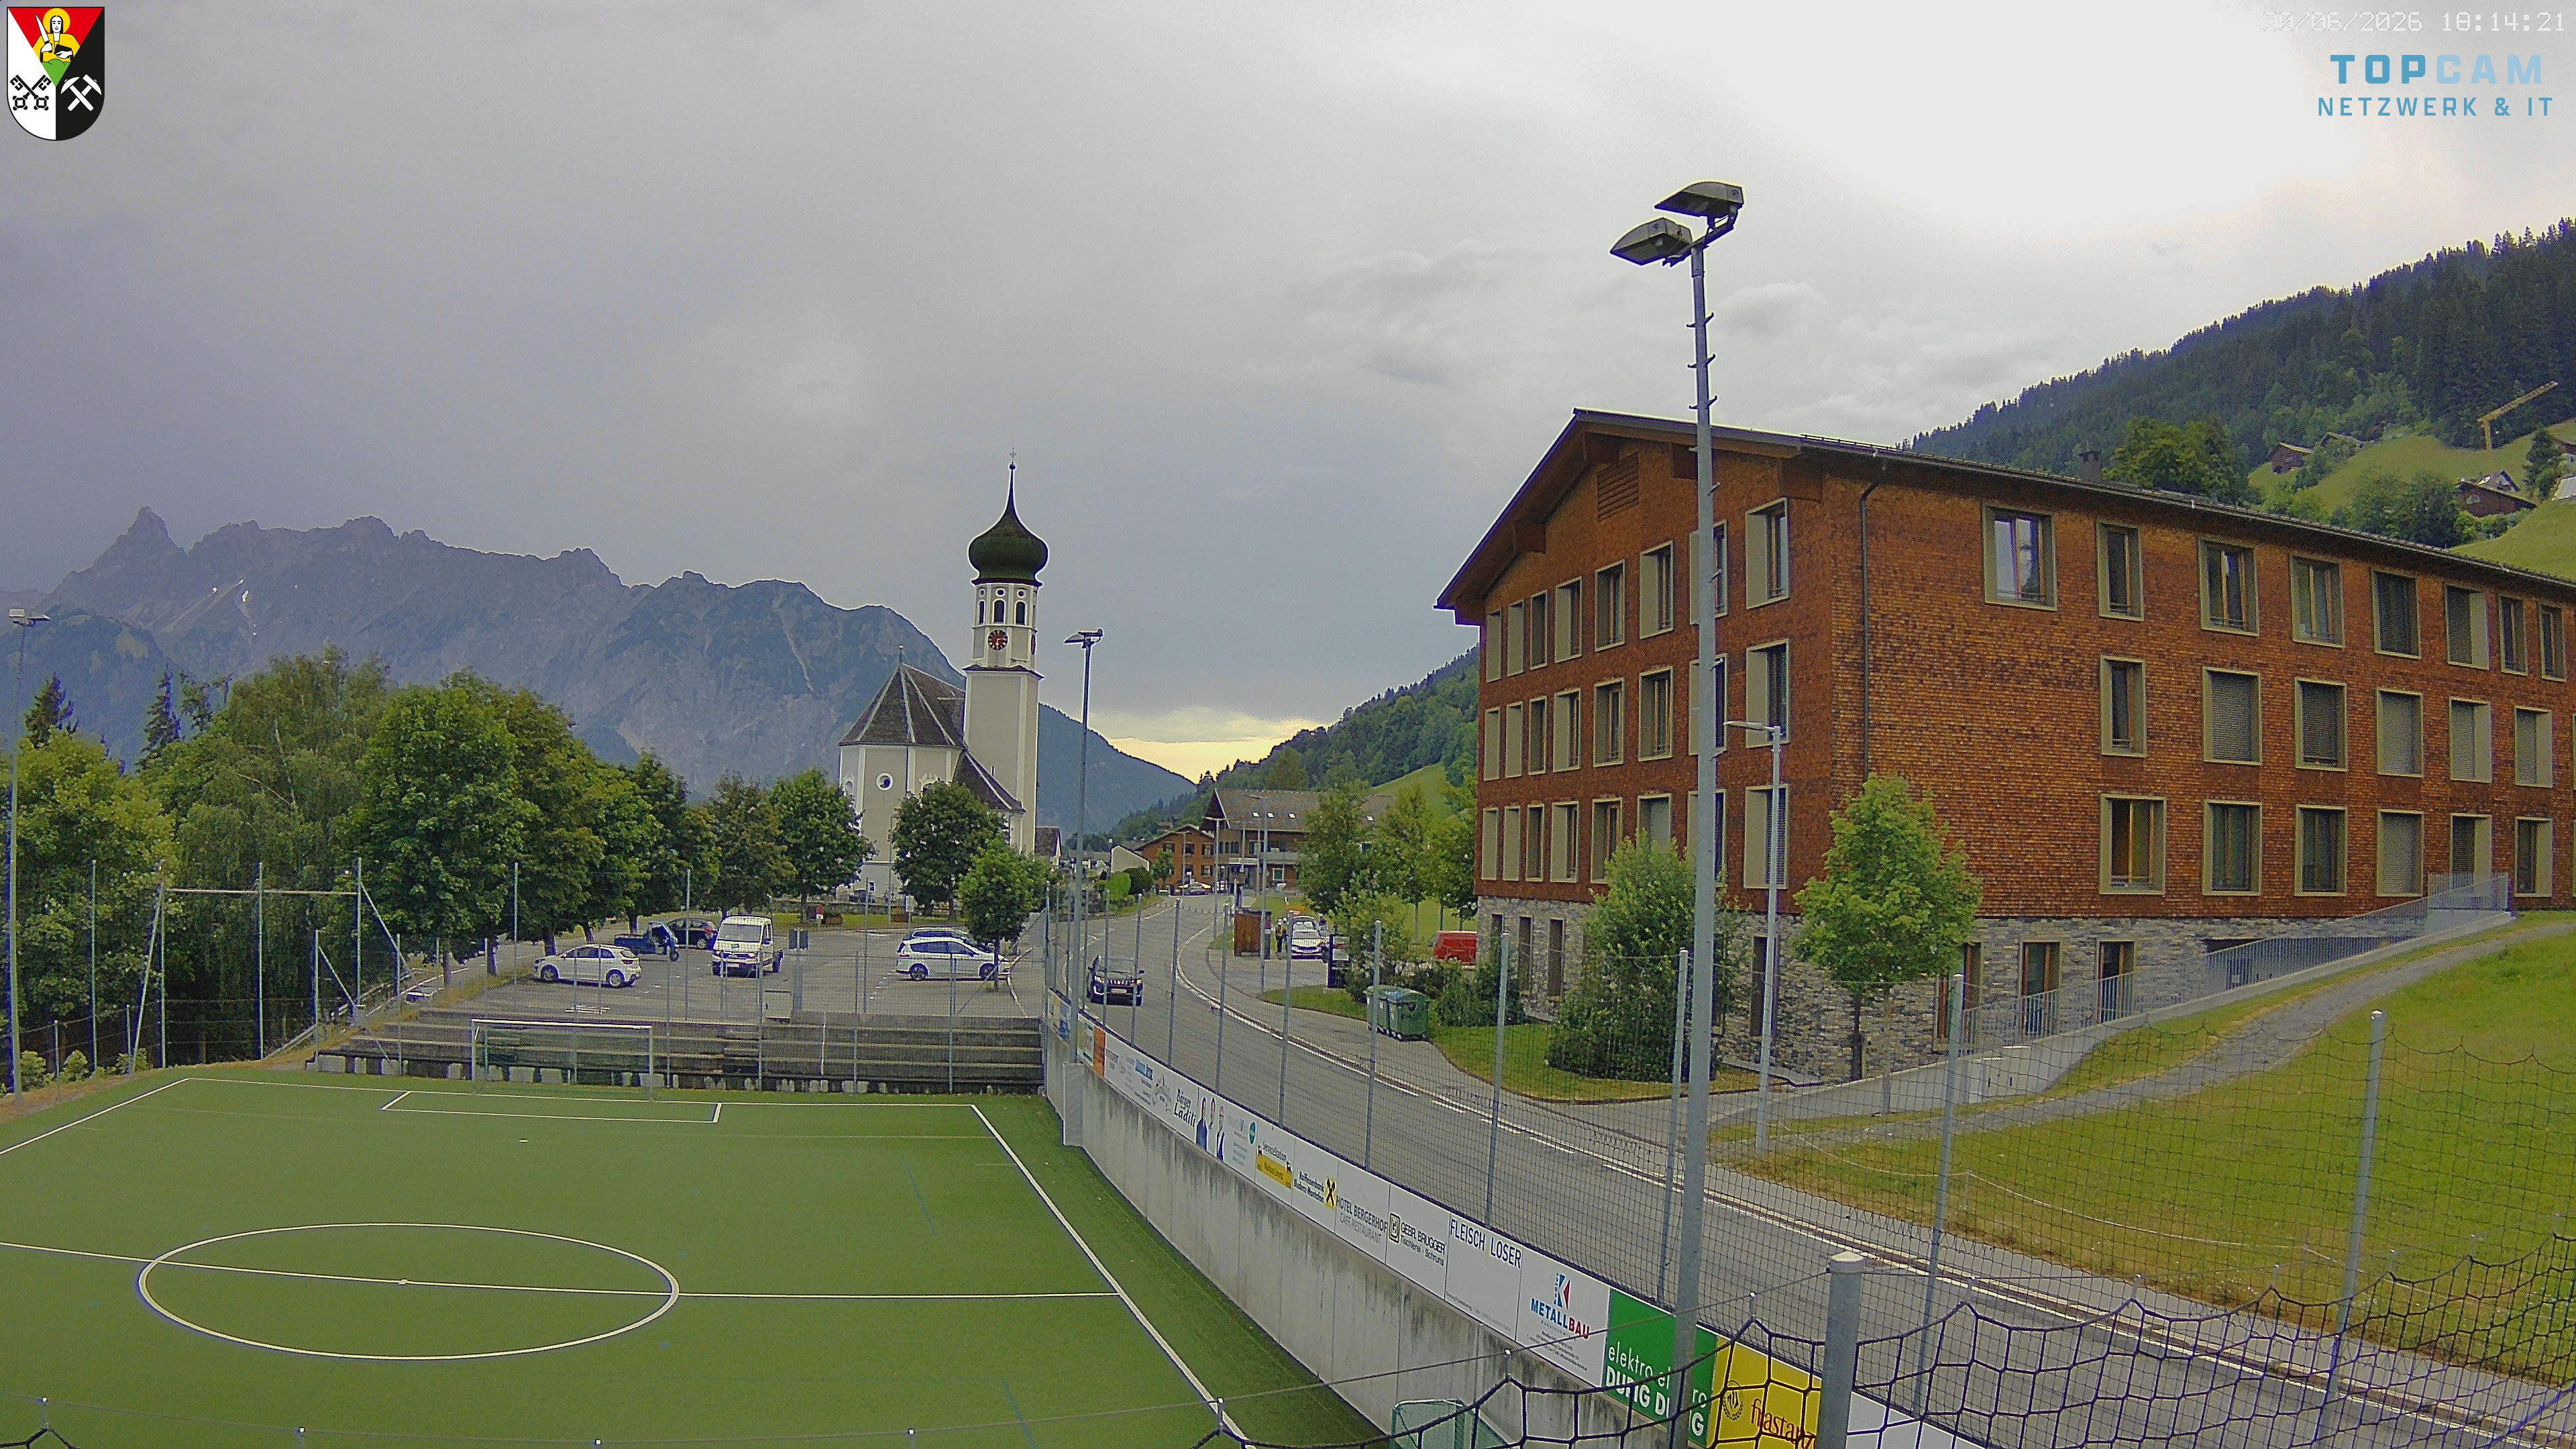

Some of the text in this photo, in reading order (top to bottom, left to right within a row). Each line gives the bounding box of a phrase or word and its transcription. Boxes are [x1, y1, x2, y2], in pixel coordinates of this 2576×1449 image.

[1336, 1195, 1388, 1233] HOTEL BERGERHOF
[1450, 1218, 1521, 1269] FLEISCH LOSER
[1531, 1297, 1590, 1340] METALLBAU
[1609, 1341, 1653, 1379] elektro
